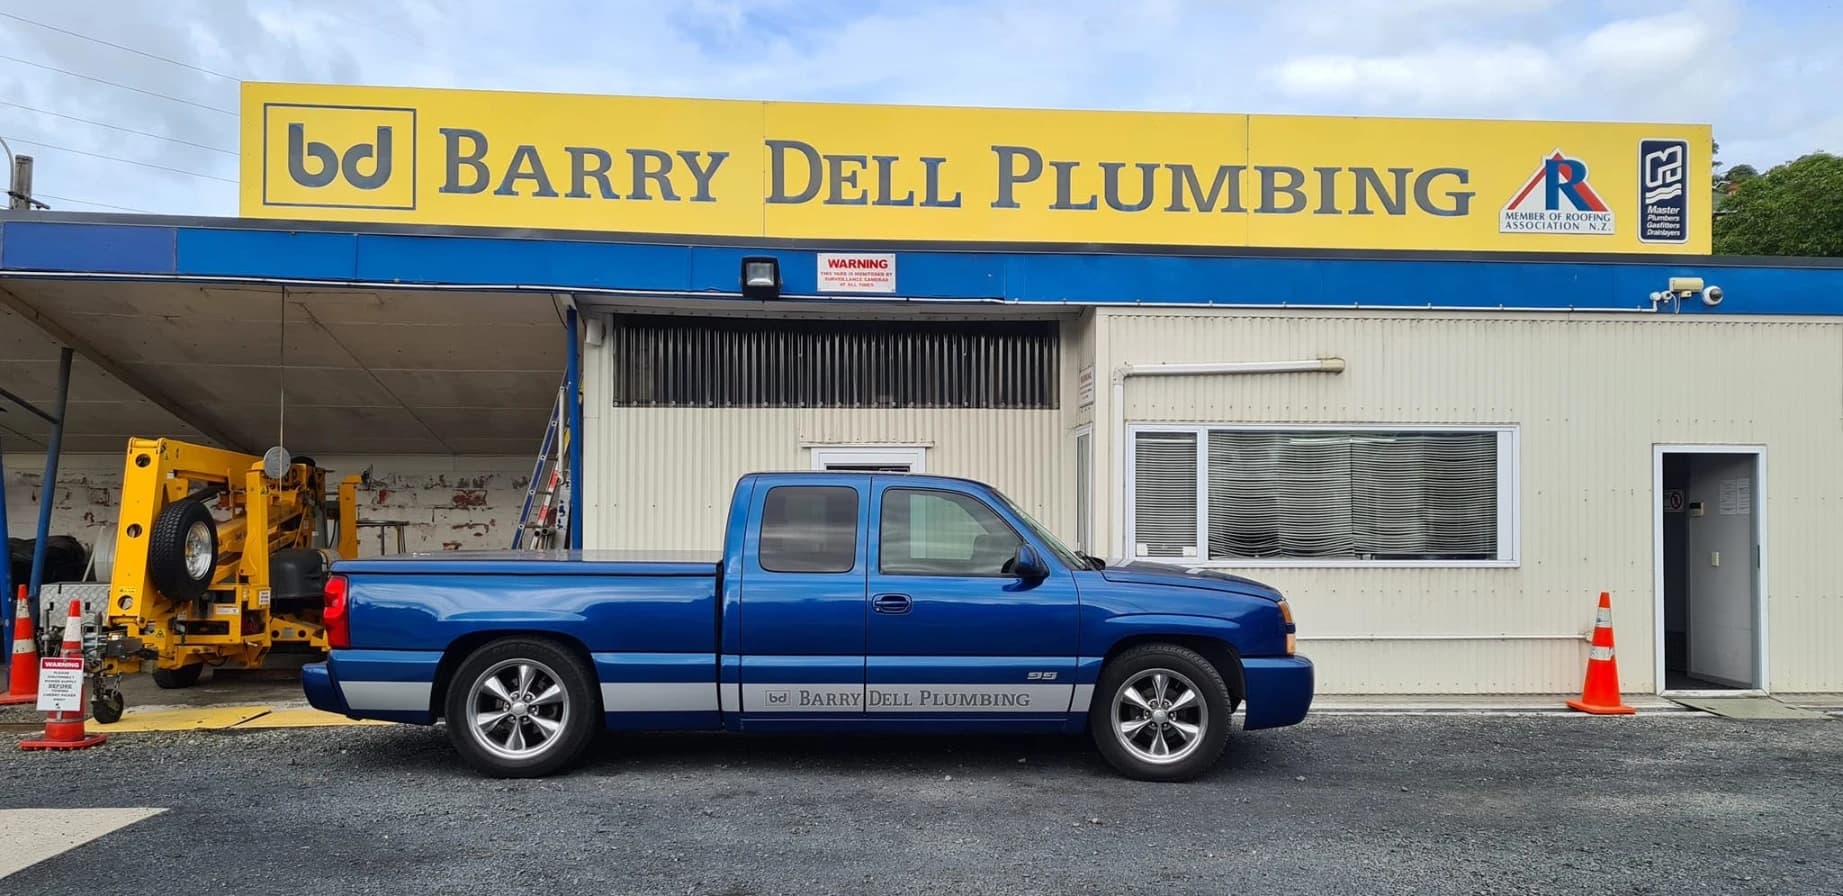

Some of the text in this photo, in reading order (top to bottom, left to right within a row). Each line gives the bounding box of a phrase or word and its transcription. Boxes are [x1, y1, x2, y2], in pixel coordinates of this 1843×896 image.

[288, 123, 392, 189] bd
[439, 128, 1475, 216] BARRY DELL PLUMBING
[1647, 205, 1680, 215] Master
[1505, 212, 1611, 222] MEMBER OF ROOFING
[1647, 214, 1680, 222] Plumbers
[1505, 221, 1612, 232] ASSOCIATION N.Z.
[1647, 221, 1680, 230] Gasfitters
[1647, 228, 1680, 237] Drainlayers
[828, 259, 888, 269] WARNING
[768, 690, 1030, 706] bd BARRY DELL PLUMBING
